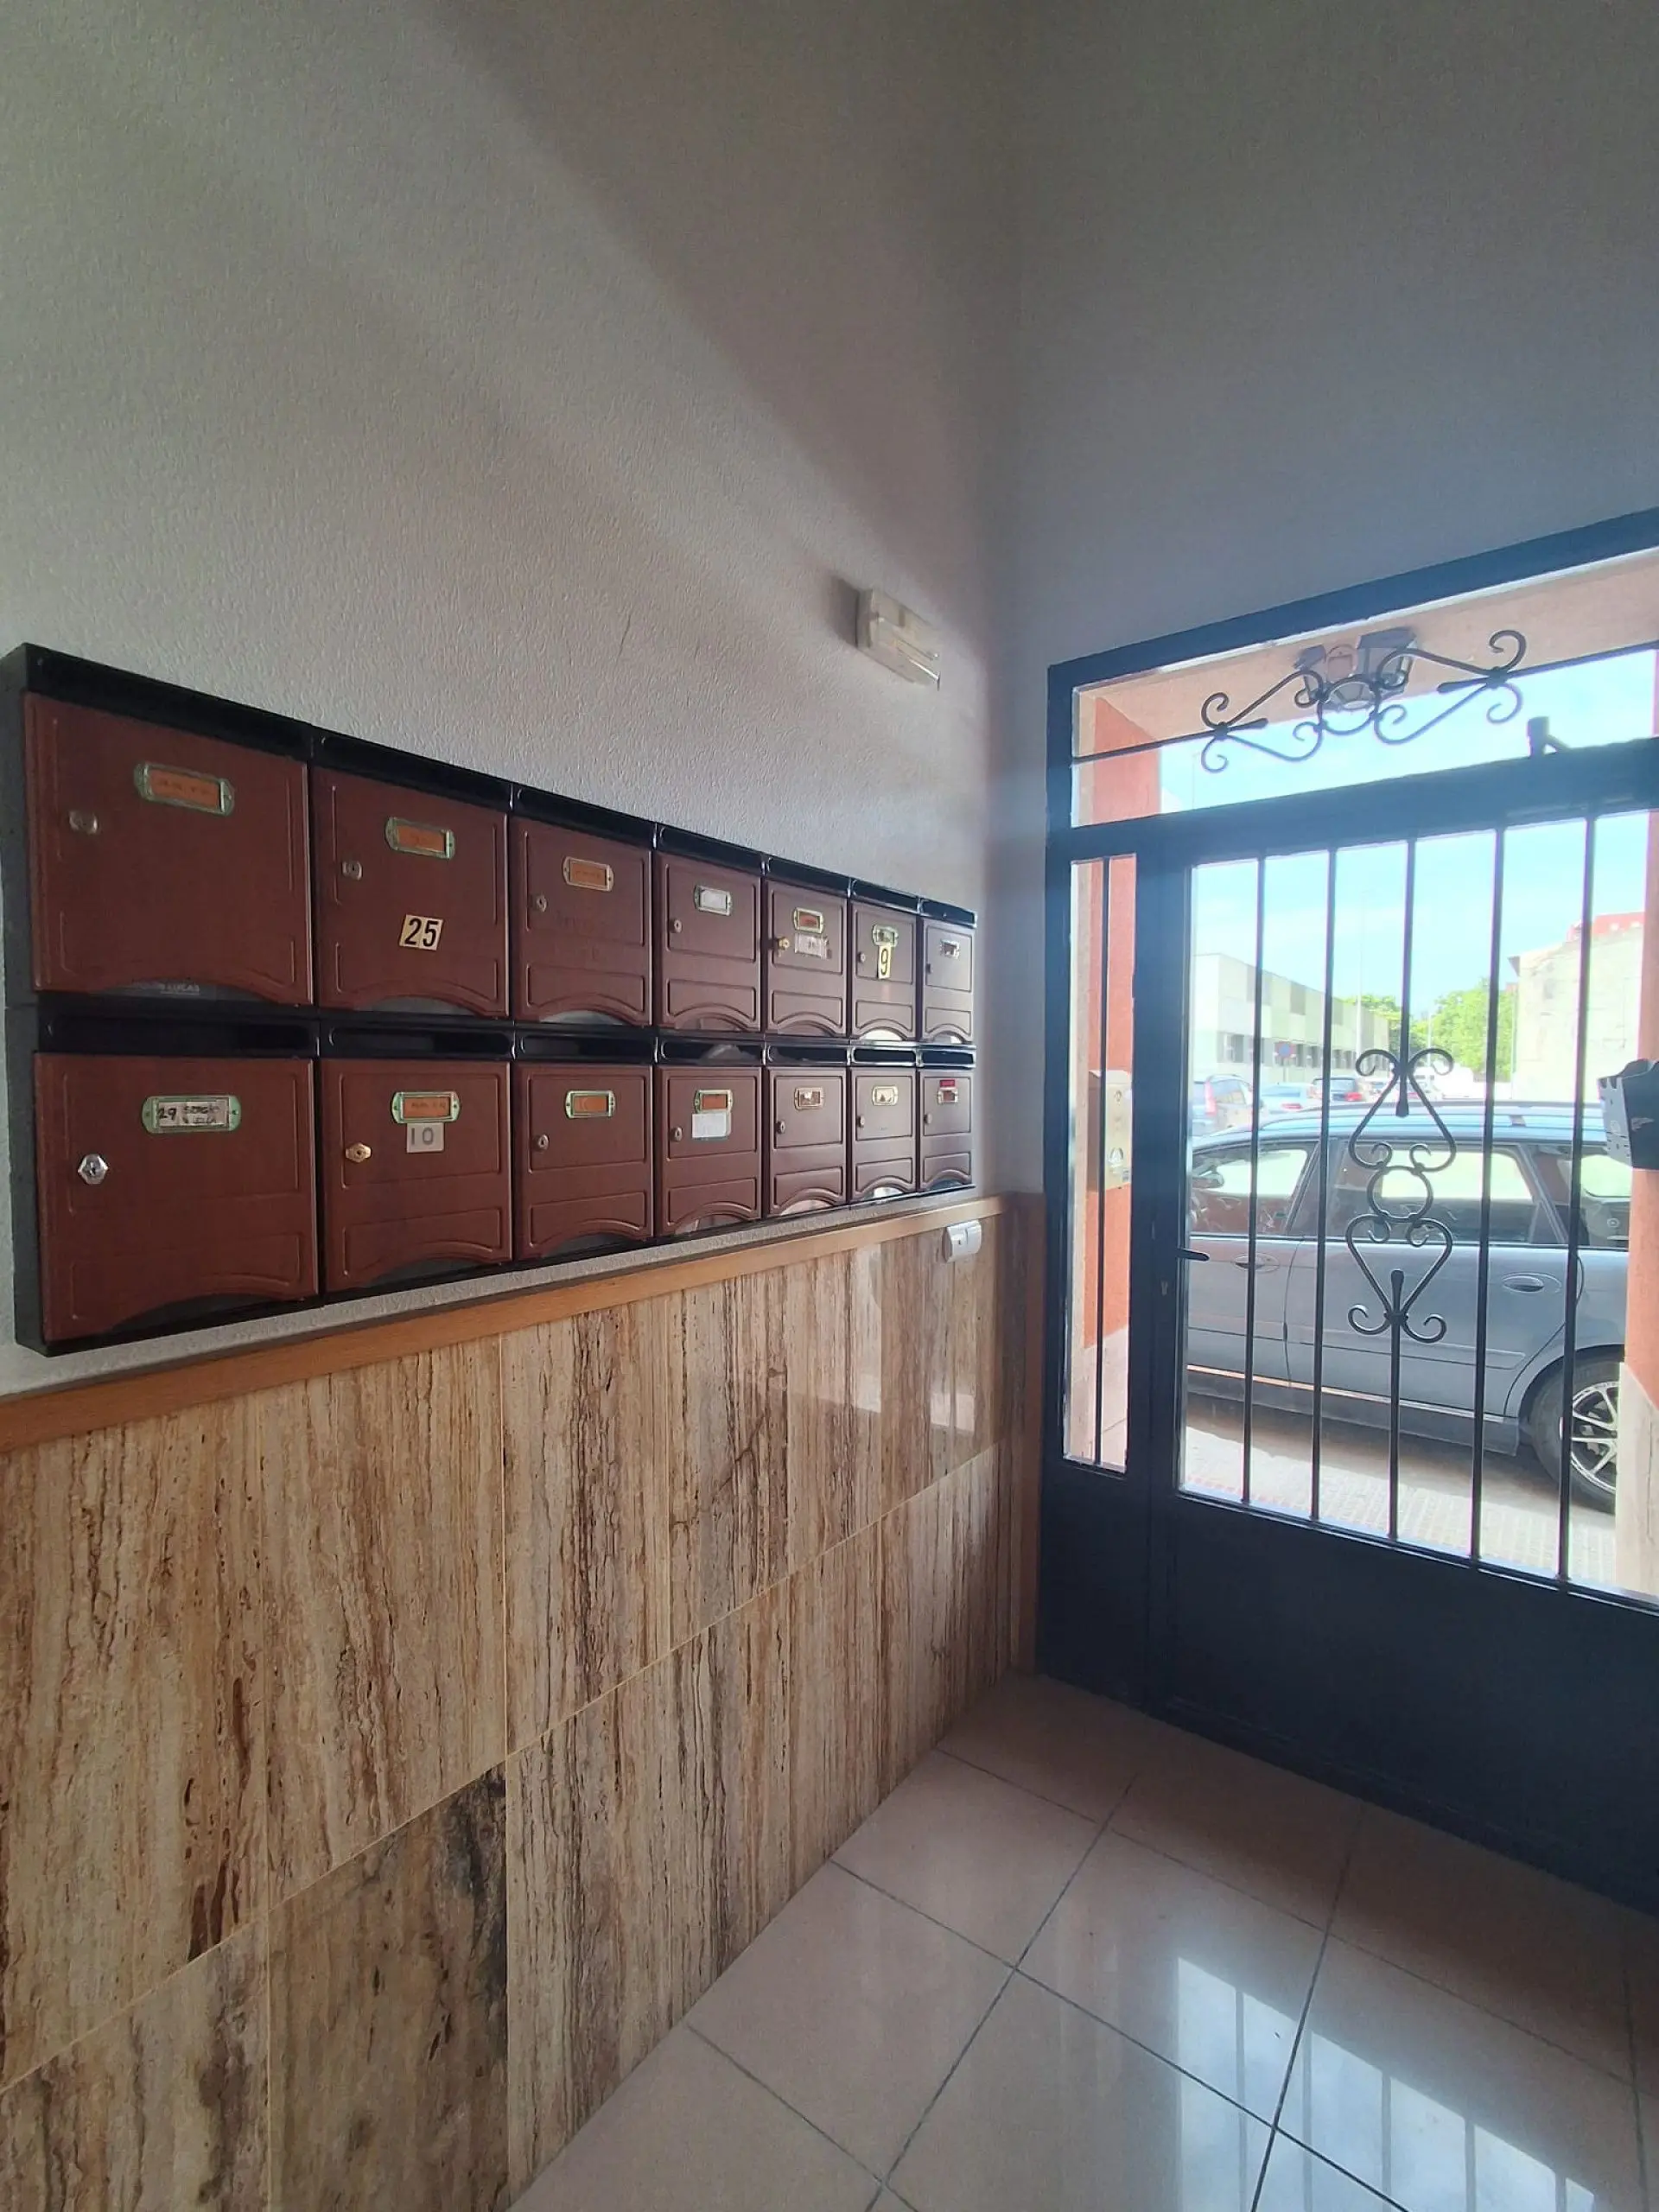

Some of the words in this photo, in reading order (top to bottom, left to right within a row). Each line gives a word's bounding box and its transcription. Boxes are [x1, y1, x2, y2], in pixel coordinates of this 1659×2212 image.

[404, 918, 439, 947] 25
[880, 949, 888, 976] 9
[157, 1107, 177, 1121] 29
[411, 1127, 434, 1146] 10
